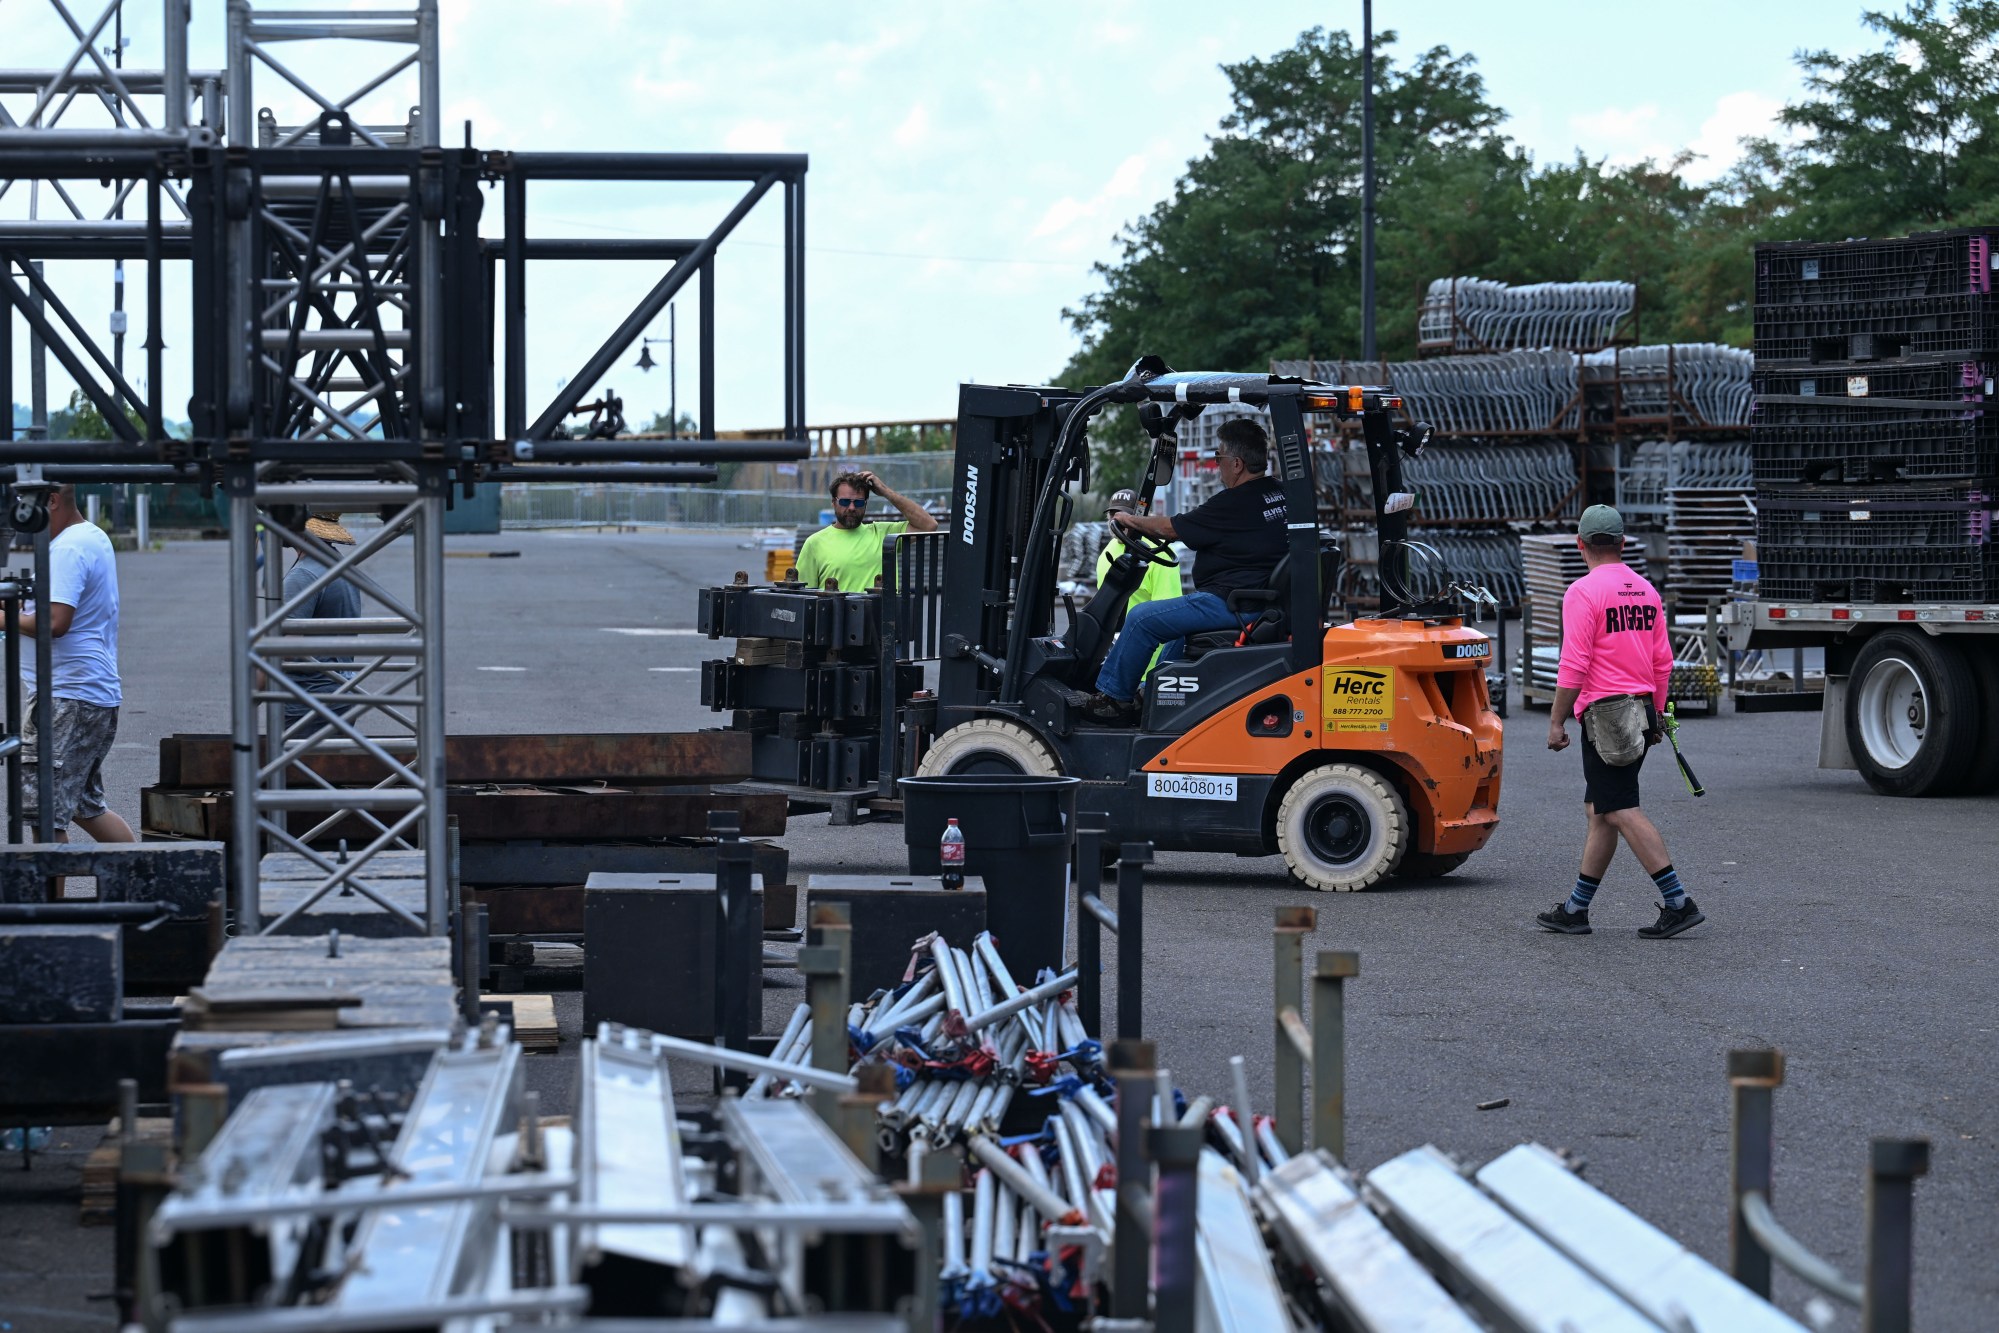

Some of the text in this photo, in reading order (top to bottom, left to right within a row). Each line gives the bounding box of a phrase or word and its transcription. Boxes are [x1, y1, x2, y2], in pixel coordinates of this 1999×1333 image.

[963, 464, 979, 545] DOOSAN
[1263, 506, 1282, 518] ELVIS
[1157, 676, 1199, 692] 25
[1333, 677, 1385, 694] Herc
[1346, 696, 1381, 705] Rentals
[1154, 779, 1233, 796] 800408015
